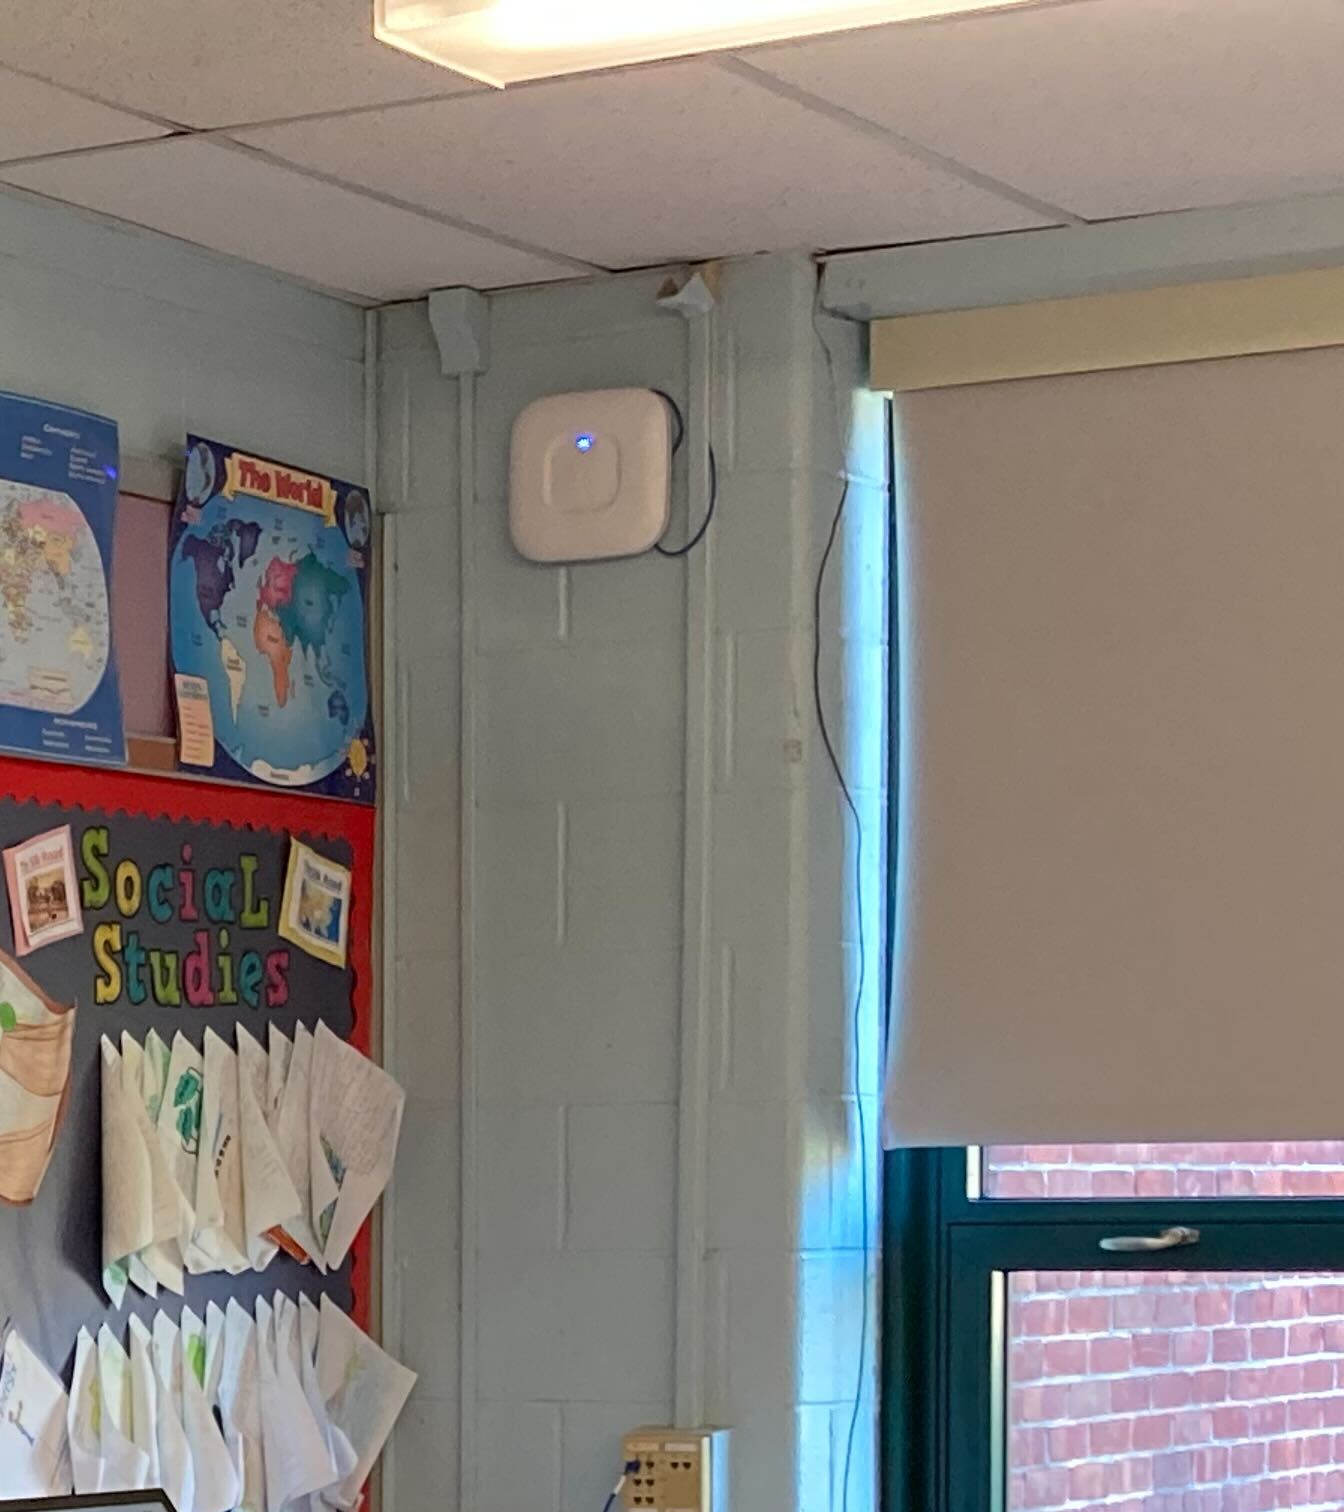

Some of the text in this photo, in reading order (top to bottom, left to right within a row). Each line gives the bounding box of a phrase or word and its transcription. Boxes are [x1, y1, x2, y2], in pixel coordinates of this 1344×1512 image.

[237, 459, 324, 511] The World
[92, 921, 290, 1008] Studies
